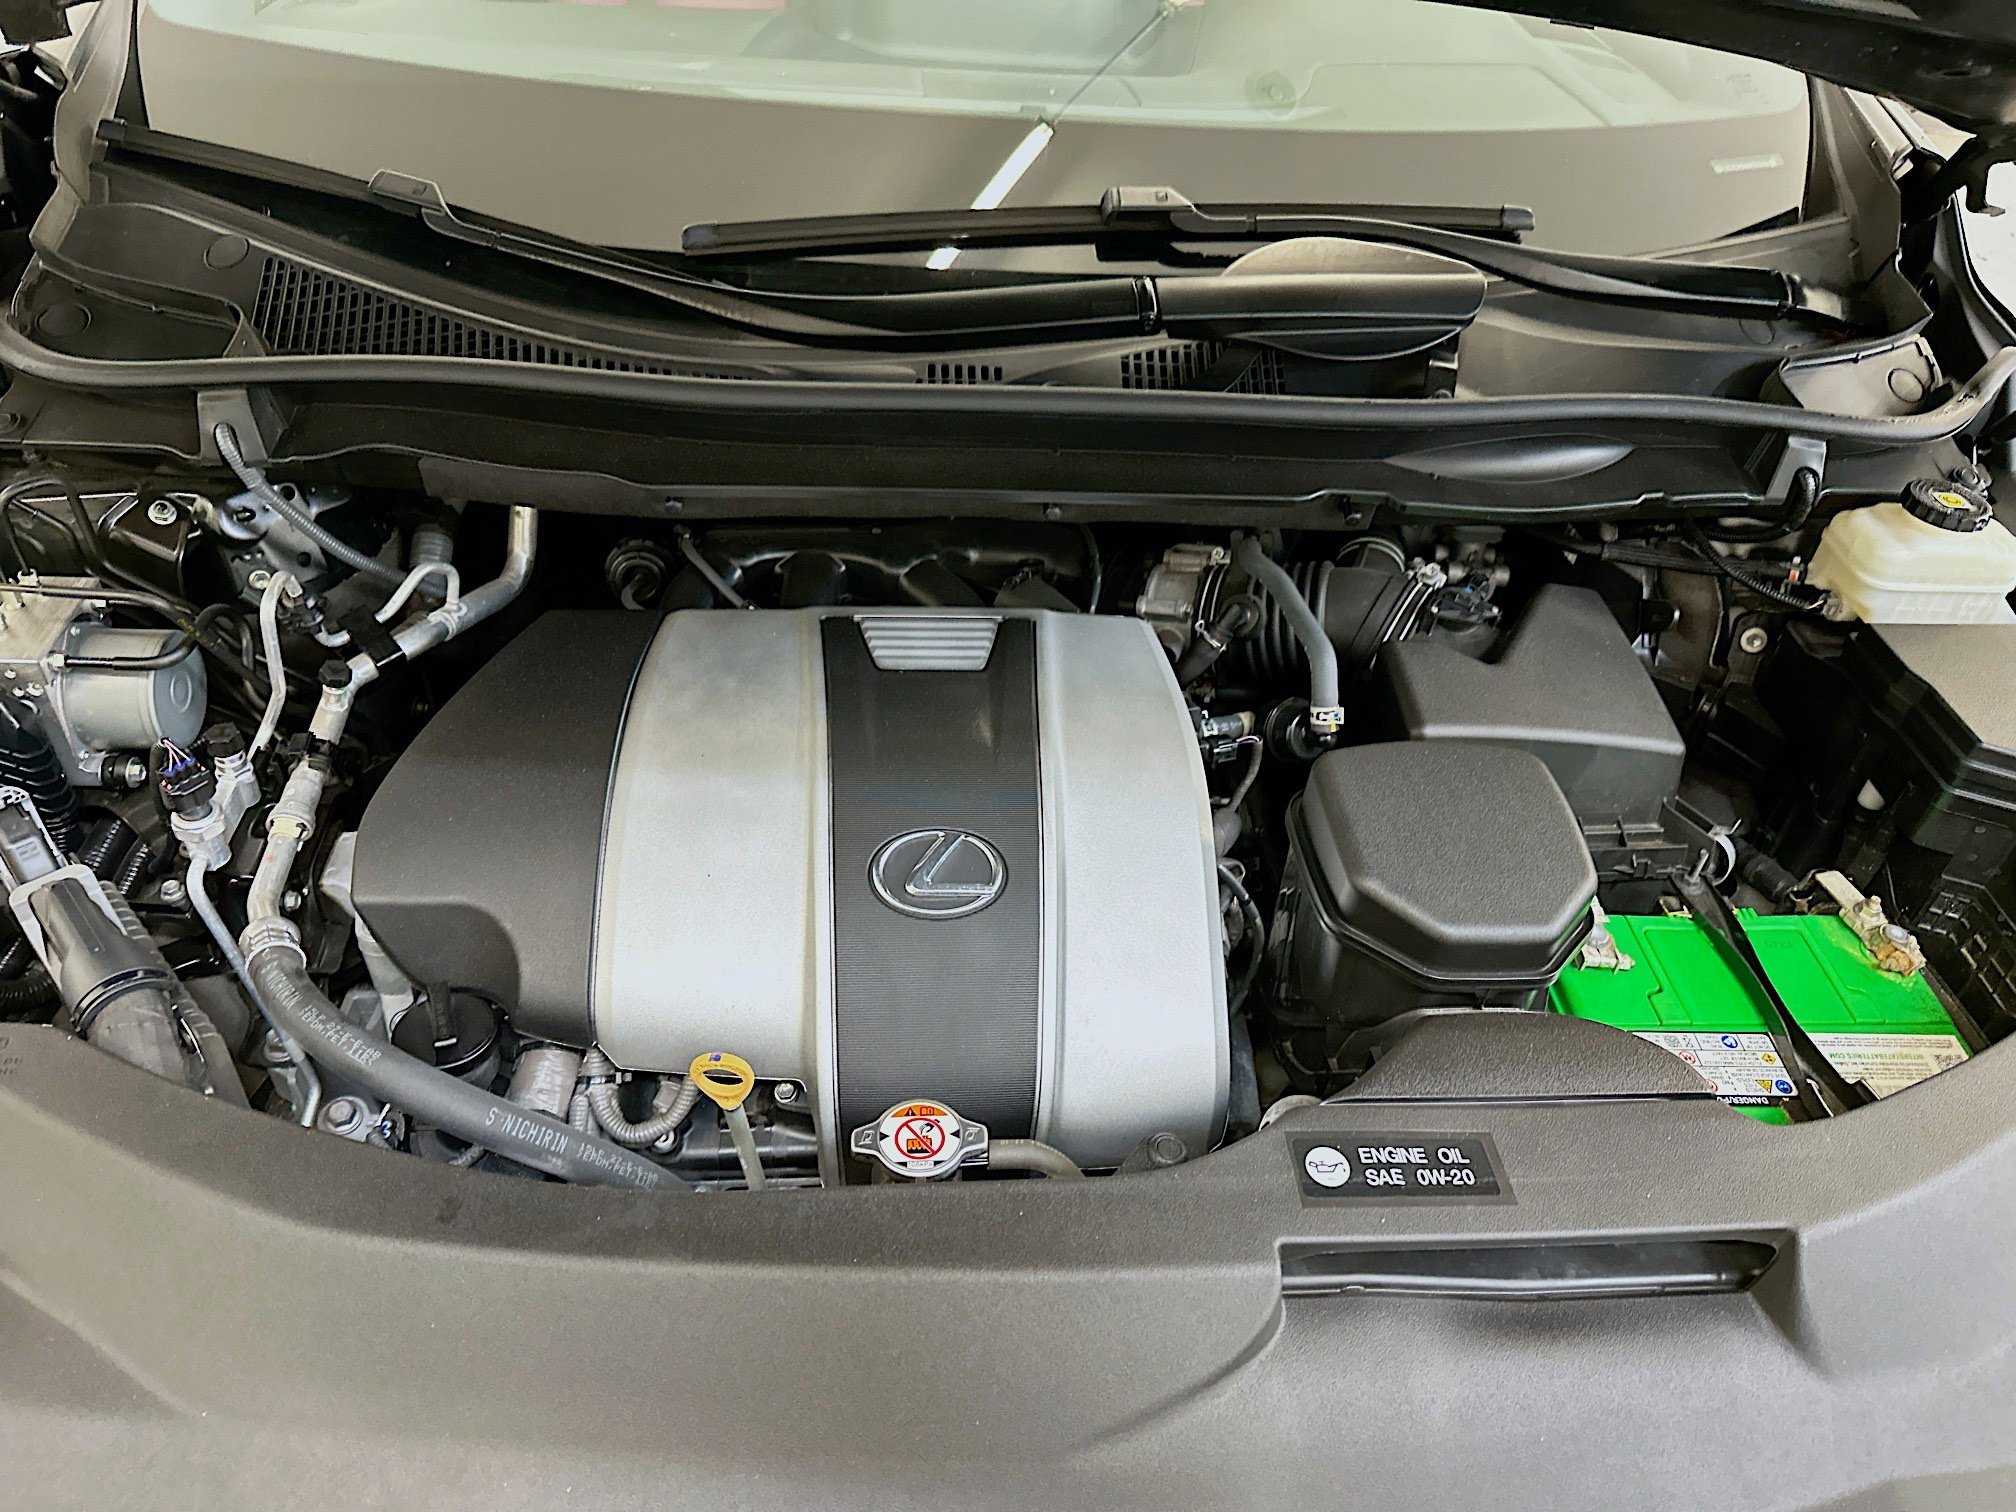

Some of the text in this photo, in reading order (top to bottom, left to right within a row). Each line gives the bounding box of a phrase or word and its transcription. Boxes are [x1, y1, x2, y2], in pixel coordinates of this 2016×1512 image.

[1357, 1147, 1470, 1164] ENGINE OIL
[1365, 1168, 1476, 1186] SAE 0W-20
